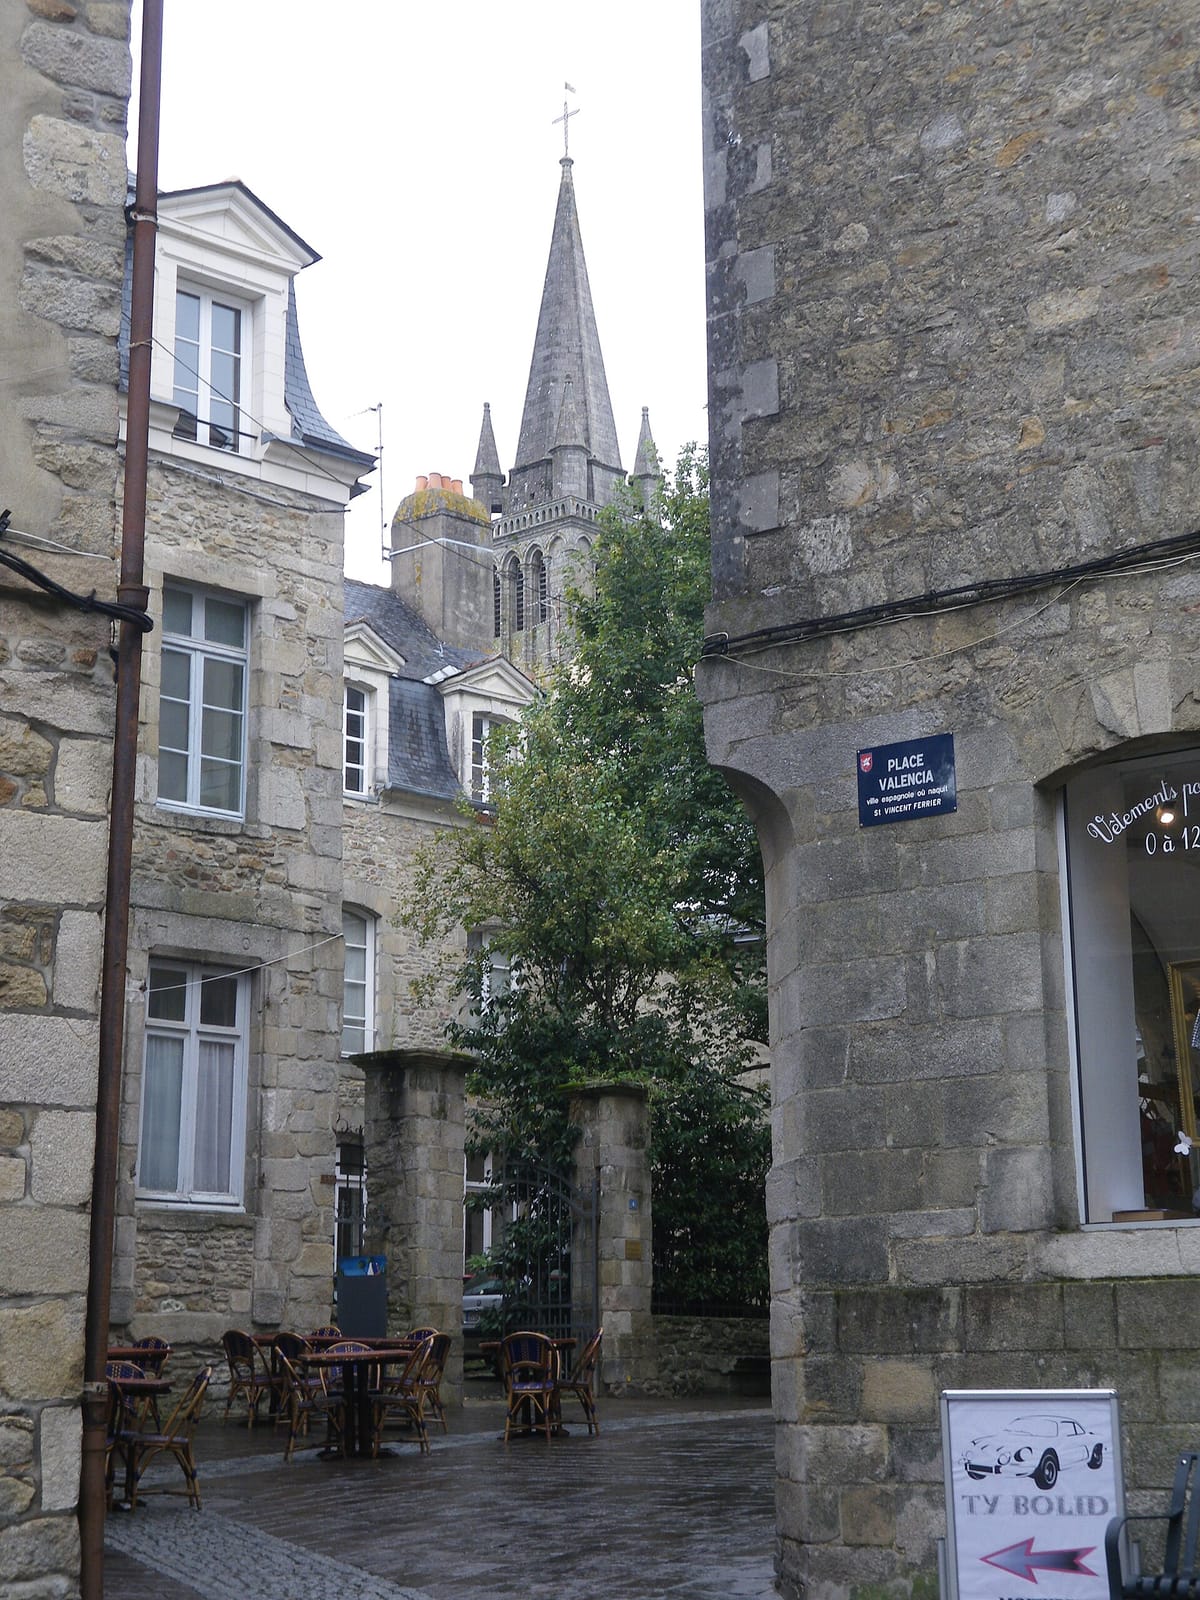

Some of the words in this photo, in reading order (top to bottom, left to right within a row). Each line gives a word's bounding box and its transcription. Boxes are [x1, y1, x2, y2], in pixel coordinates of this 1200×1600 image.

[888, 753, 924, 772] PLACE
[879, 769, 934, 791] VALENCIA
[866, 797, 879, 806] ville
[881, 791, 915, 803] espagnole
[917, 788, 926, 797] où
[927, 784, 949, 795] naquit
[873, 809, 881, 817] St
[884, 803, 912, 815] VINCENT
[913, 798, 942, 810] FERRIER
[1086, 780, 1178, 843] Vêtements
[1162, 834, 1176, 853] à
[1181, 825, 1200, 850] 12
[961, 1494, 1000, 1516] TY
[1013, 1494, 1109, 1517] BOLID
